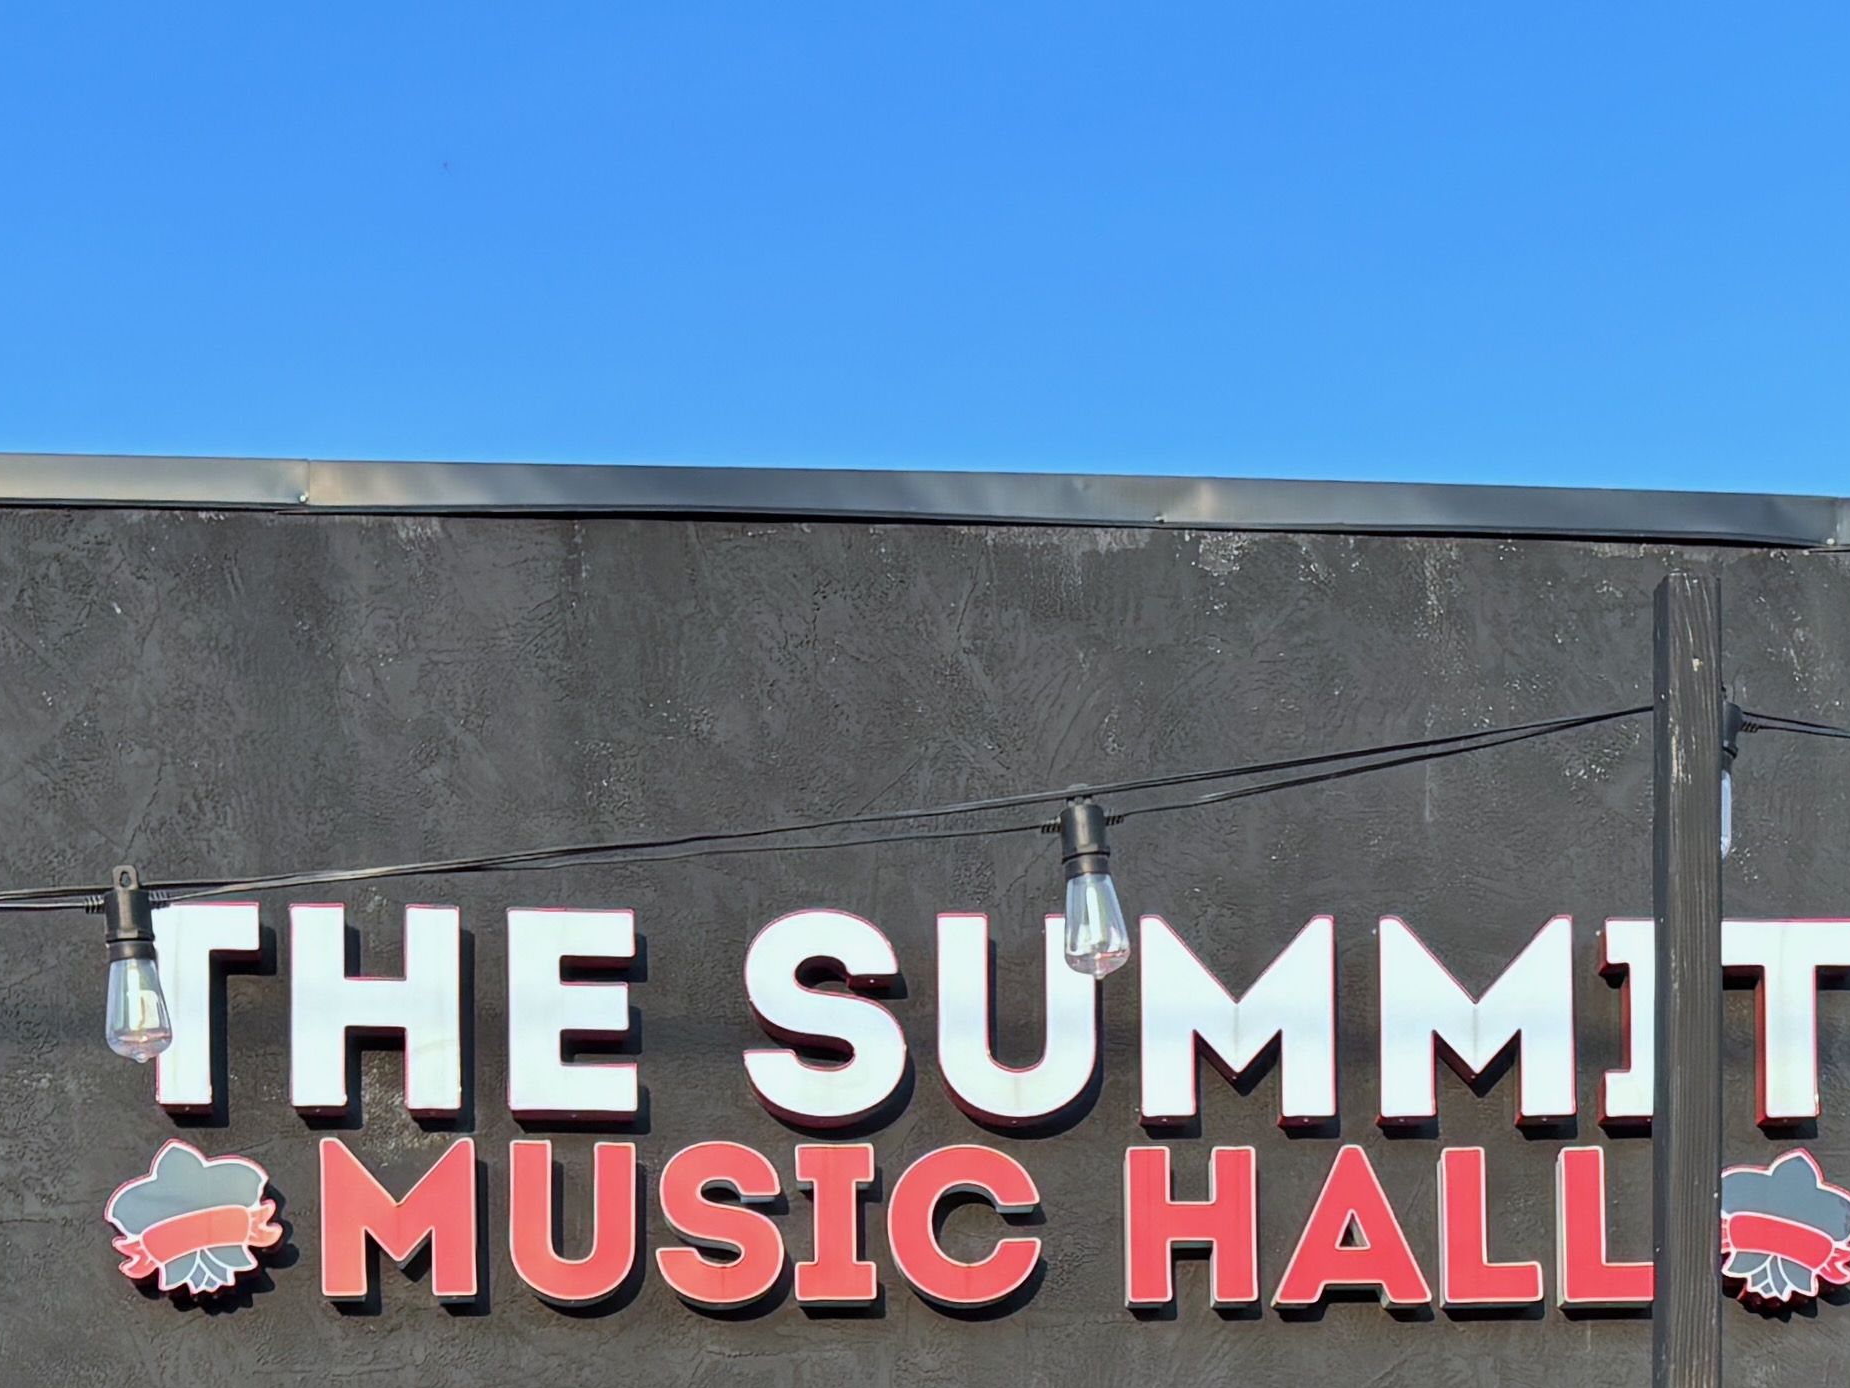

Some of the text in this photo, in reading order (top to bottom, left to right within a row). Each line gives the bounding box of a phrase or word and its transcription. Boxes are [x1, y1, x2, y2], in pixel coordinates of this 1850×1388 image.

[151, 902, 637, 1120] THE
[320, 1137, 1653, 1306] MUSIC HALL
